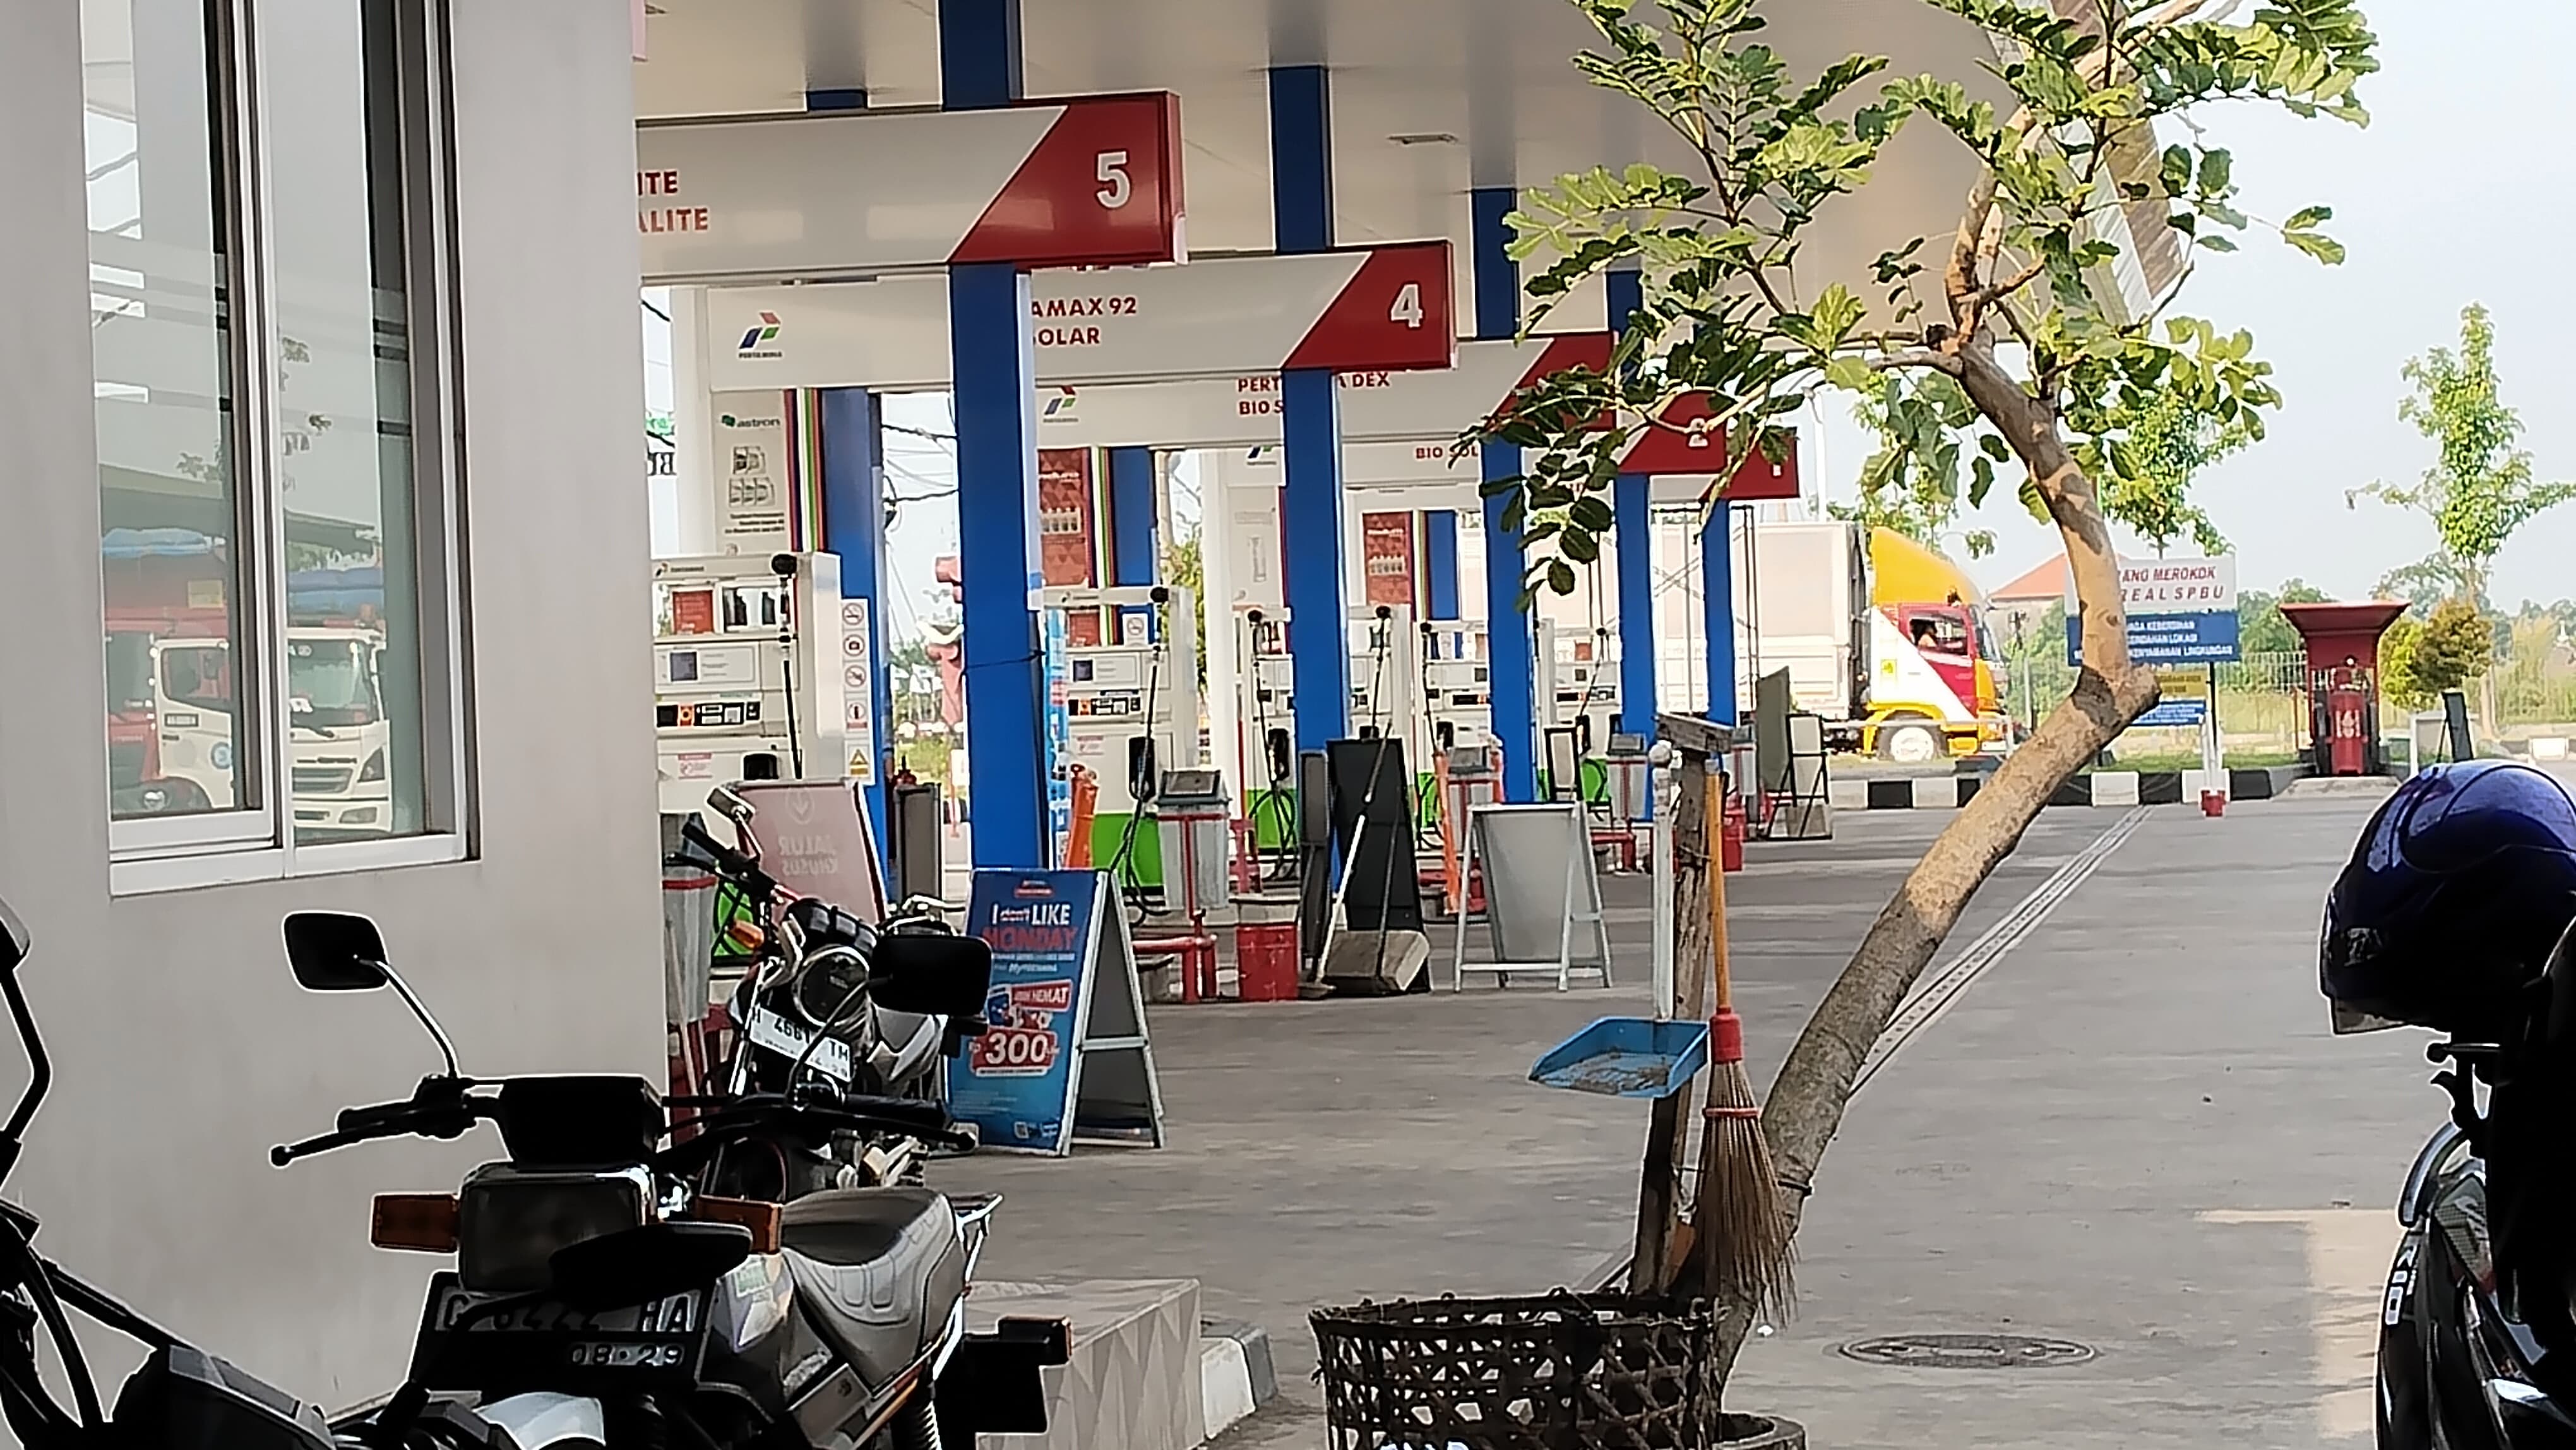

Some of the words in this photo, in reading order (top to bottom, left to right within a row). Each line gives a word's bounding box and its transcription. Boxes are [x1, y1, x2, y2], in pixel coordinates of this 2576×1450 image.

[1095, 150, 1131, 210] 5
[1109, 296, 1137, 315] 92
[1390, 283, 1424, 329] 4
[1033, 327, 1100, 347] OLAR
[1352, 373, 1390, 388] DEX
[1239, 400, 1270, 415] BIO
[1416, 446, 1443, 459] BIO
[2174, 584, 2224, 600] SPBU
[1031, 904, 1071, 926] LIKE
[982, 926, 1078, 952] MONDAY
[751, 1005, 761, 1024] H
[829, 1040, 849, 1062] TH
[985, 1033, 1048, 1065] 300
